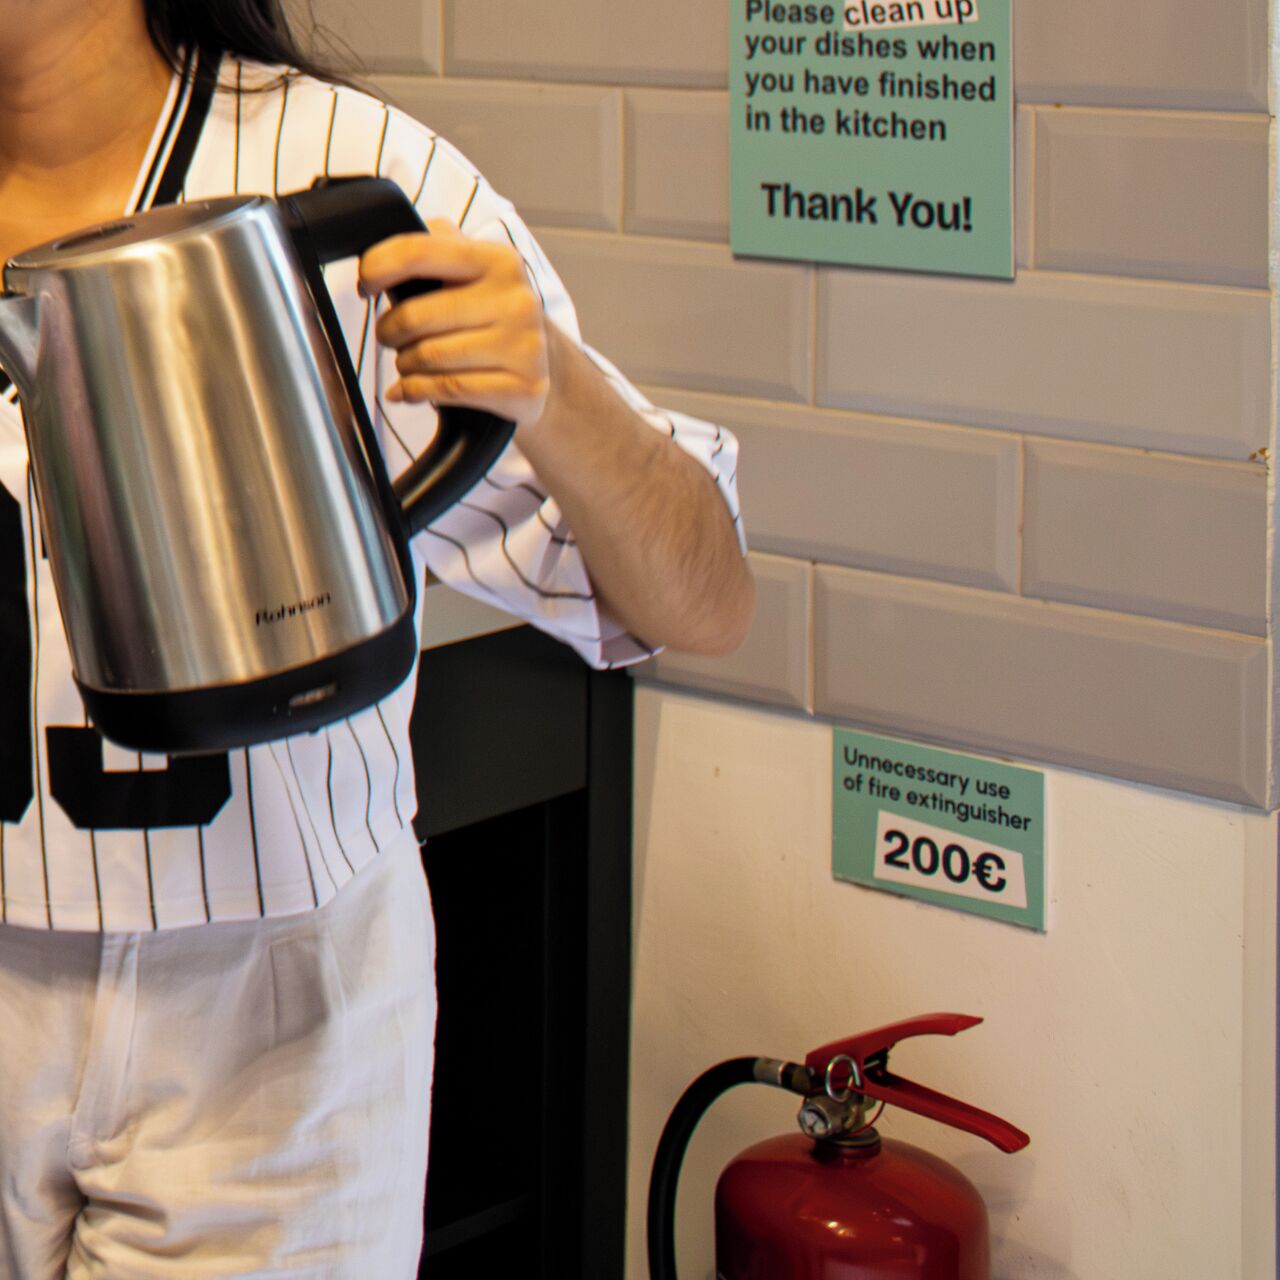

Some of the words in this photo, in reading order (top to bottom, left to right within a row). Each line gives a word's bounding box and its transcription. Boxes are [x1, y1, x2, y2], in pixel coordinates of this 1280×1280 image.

[744, 31, 807, 61] your
[814, 31, 908, 59] dishes
[917, 33, 996, 62] when
[744, 70, 795, 99] you
[804, 68, 870, 97] have
[878, 71, 997, 102] finished
[744, 104, 771, 133] in
[780, 106, 825, 135] the
[835, 108, 947, 142] kitchen
[760, 181, 879, 225] Thank
[887, 190, 974, 234] You!
[842, 745, 970, 797] Unnecessary
[975, 778, 1011, 800] use
[843, 773, 864, 793] of
[867, 779, 901, 802] fire
[905, 789, 1033, 832] extinguisher
[883, 828, 1008, 893] 200€
